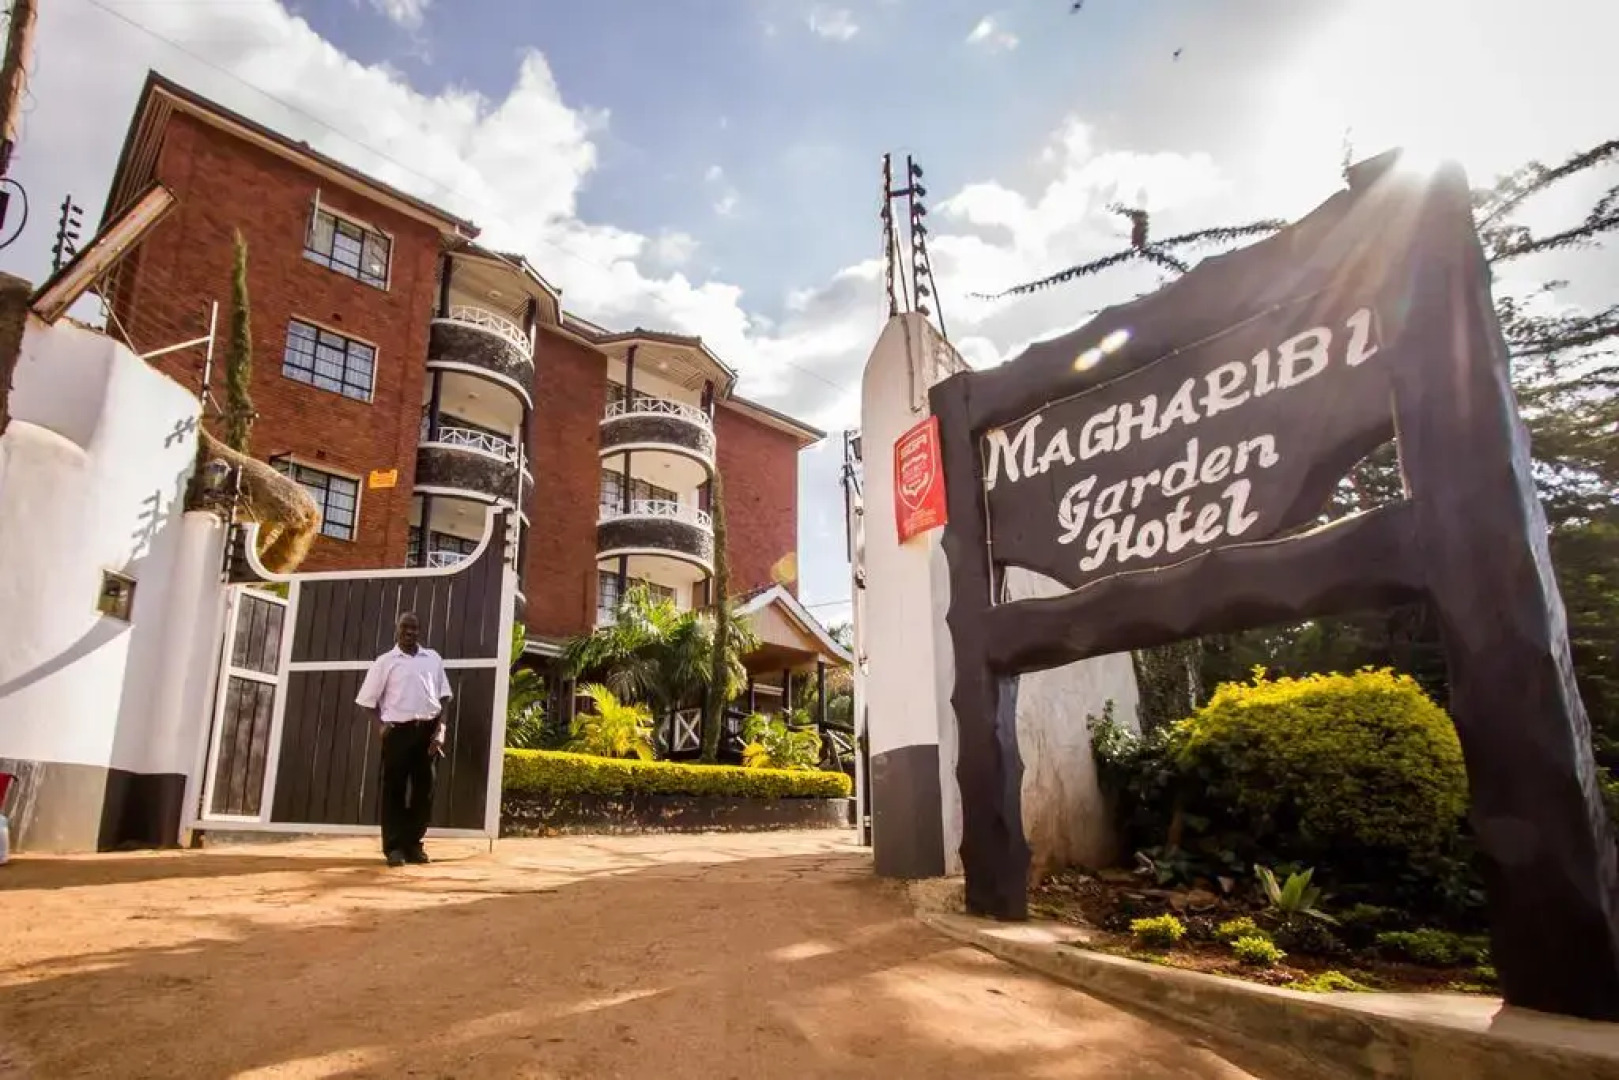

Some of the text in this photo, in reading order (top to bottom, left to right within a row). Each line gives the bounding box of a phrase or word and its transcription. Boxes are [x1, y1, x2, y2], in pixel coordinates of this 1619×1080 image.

[987, 307, 1378, 490] MAGHARIBI
[1057, 434, 1280, 545] Garden
[1079, 478, 1258, 571] Hotel
